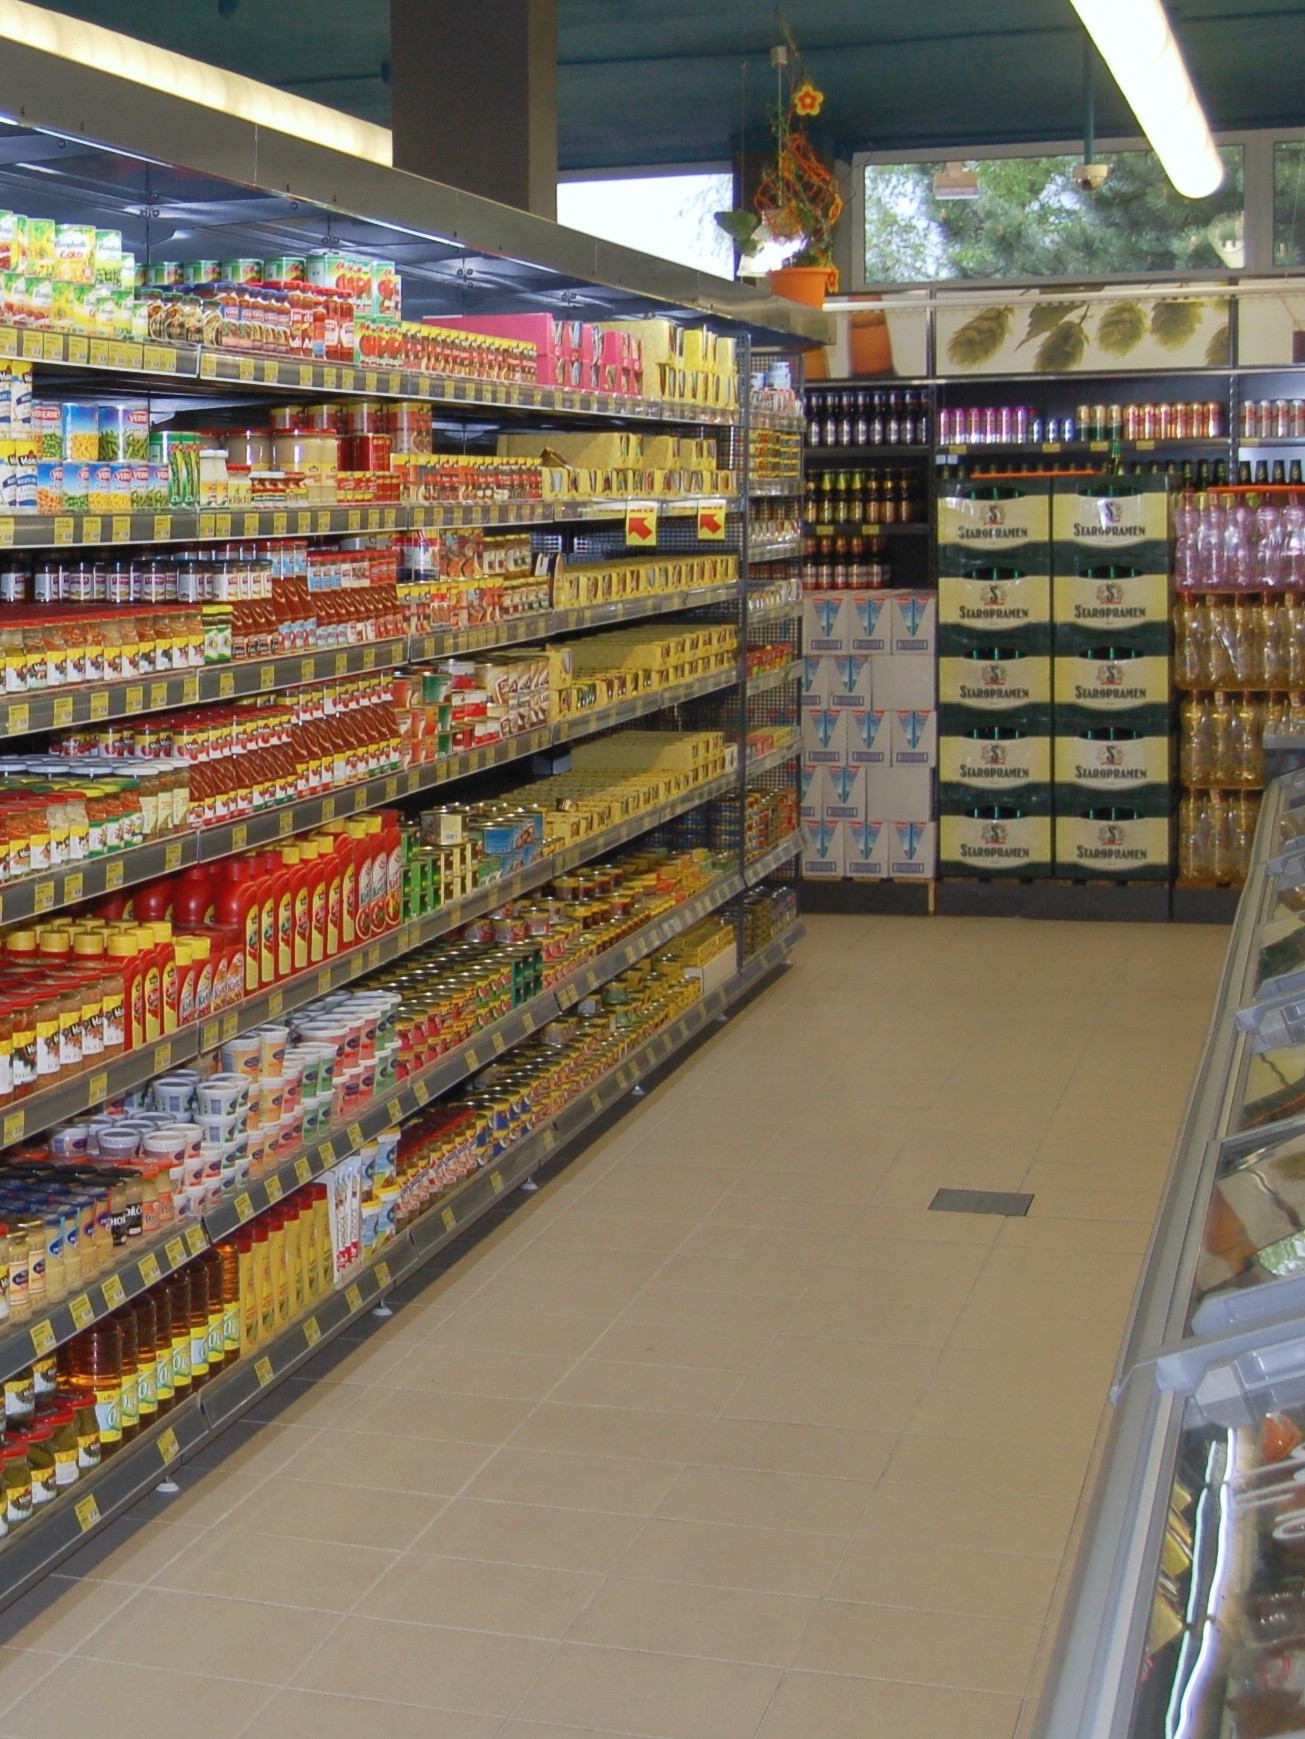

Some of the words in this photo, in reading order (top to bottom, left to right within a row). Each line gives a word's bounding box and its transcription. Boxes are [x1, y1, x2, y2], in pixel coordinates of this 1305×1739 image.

[959, 526, 1028, 539] STAROPRAMEN
[1074, 523, 1145, 537] STAROPRAMEN
[959, 605, 1028, 619] STAROPRAMEN
[1075, 604, 1145, 618] STAROPRAMEN
[959, 685, 1029, 699] STAROPRAMEN
[1075, 685, 1146, 699] STAROPRAMEN
[959, 764, 1029, 779] STAROPRAMEN
[1075, 765, 1147, 779] STAROPRAMEN
[960, 844, 1029, 858] STAROPRAMEN
[1076, 845, 1147, 859] STAROPRAMEN
